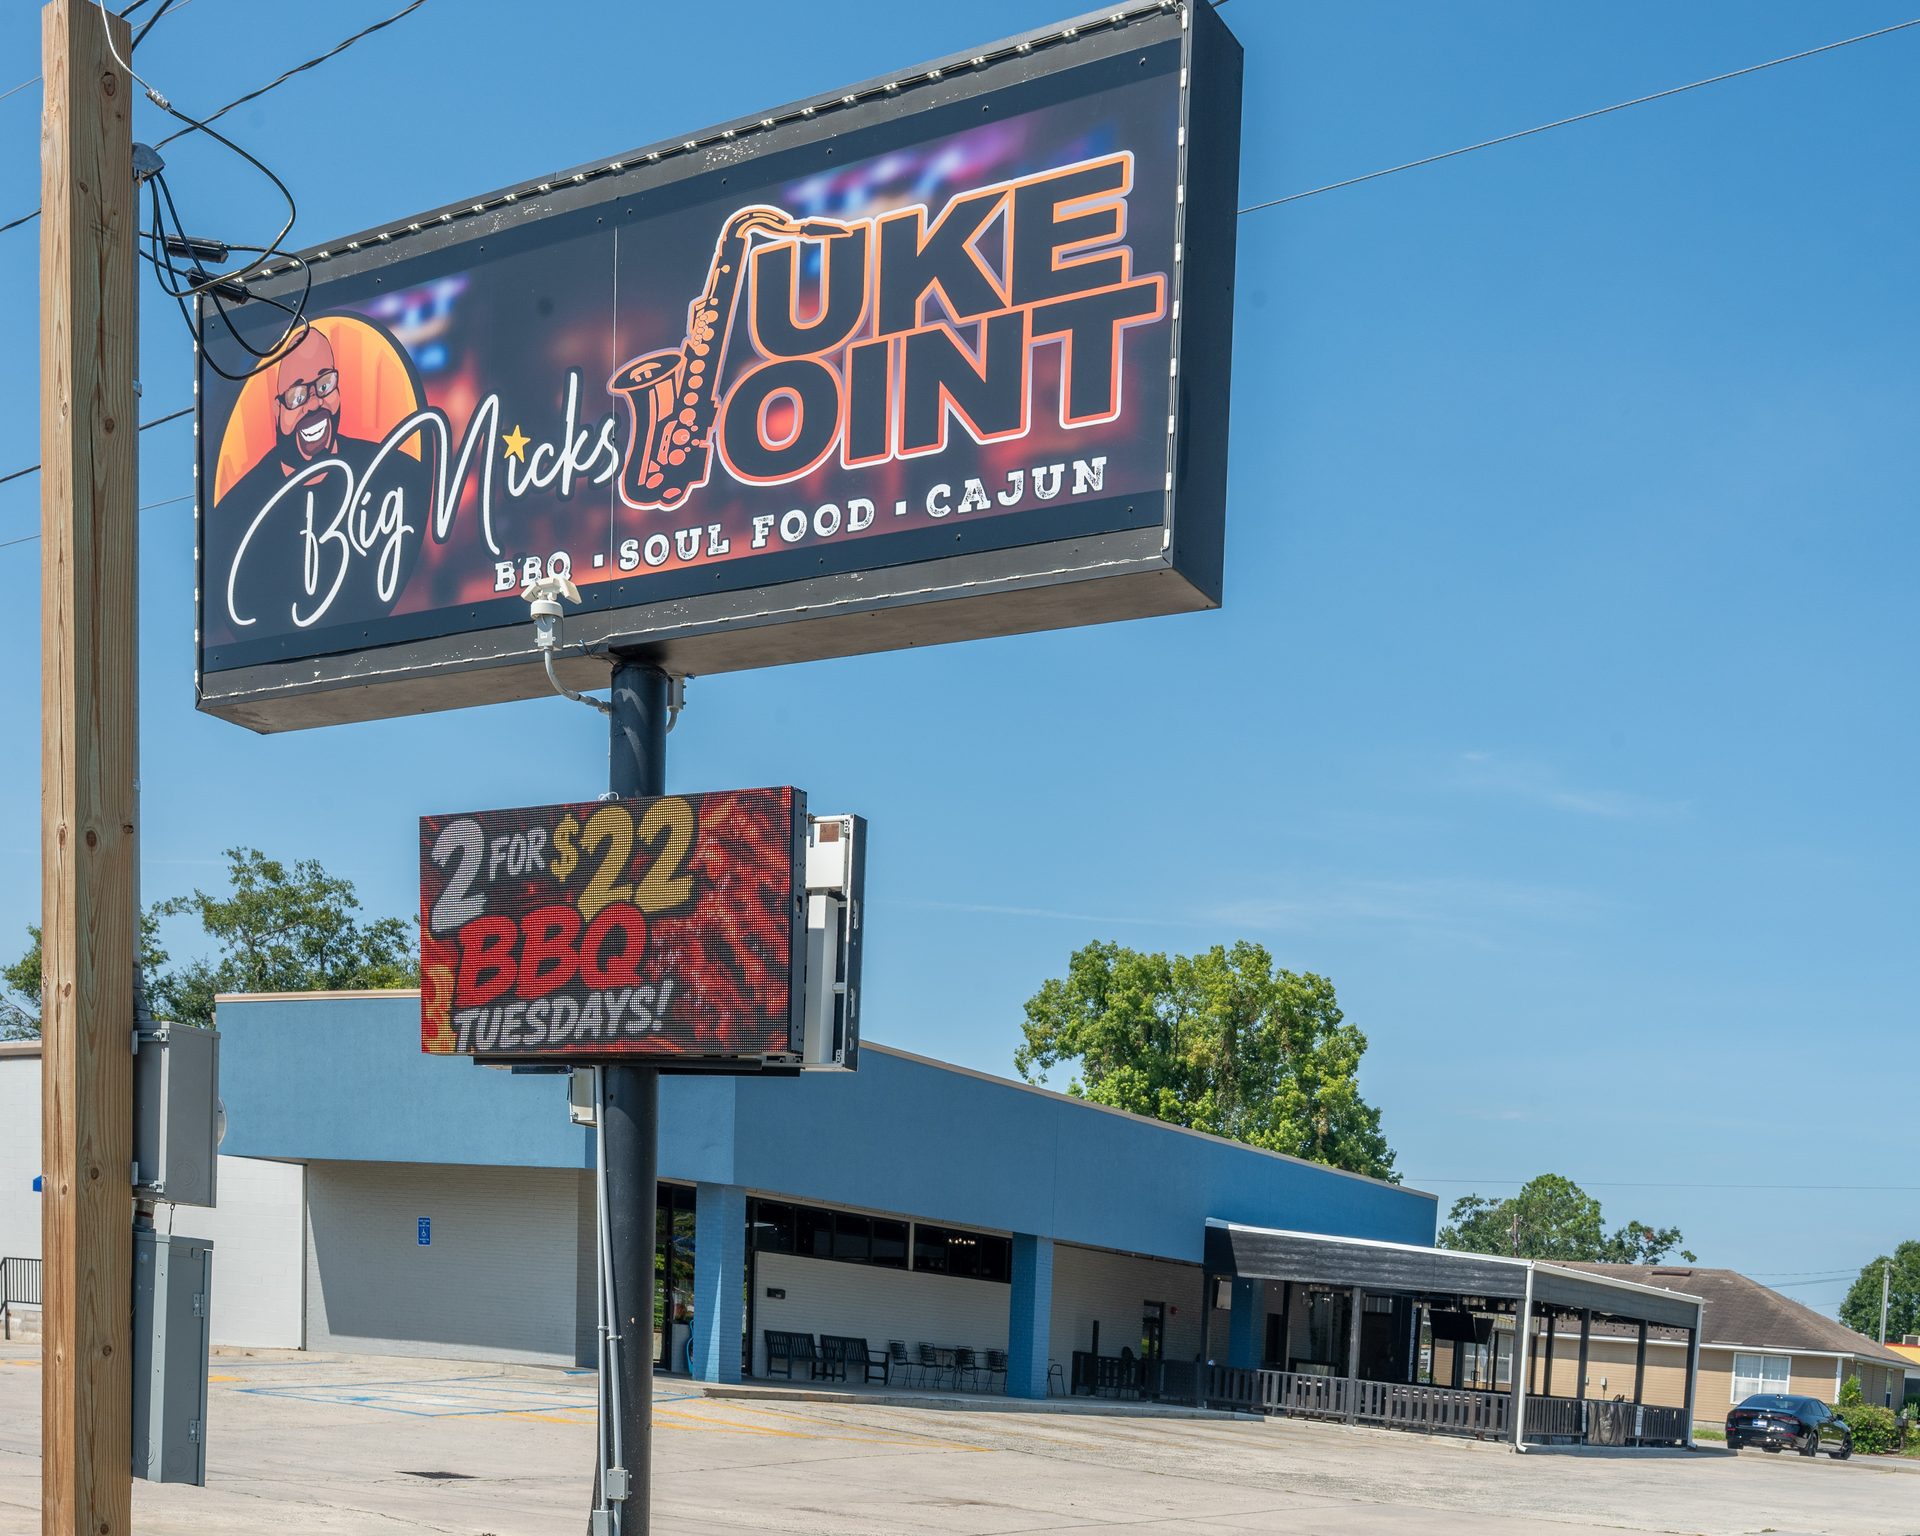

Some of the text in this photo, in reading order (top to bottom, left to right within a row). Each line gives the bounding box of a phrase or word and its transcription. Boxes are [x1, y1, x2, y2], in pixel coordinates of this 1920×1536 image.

[227, 371, 621, 627] Big Nicks
[494, 456, 1108, 592] BBQ SOUL FOOD CAJUN
[431, 797, 695, 933] 2 FOR $22
[453, 979, 674, 1053] TUESDAYS!
[456, 902, 649, 1008] BBQ
